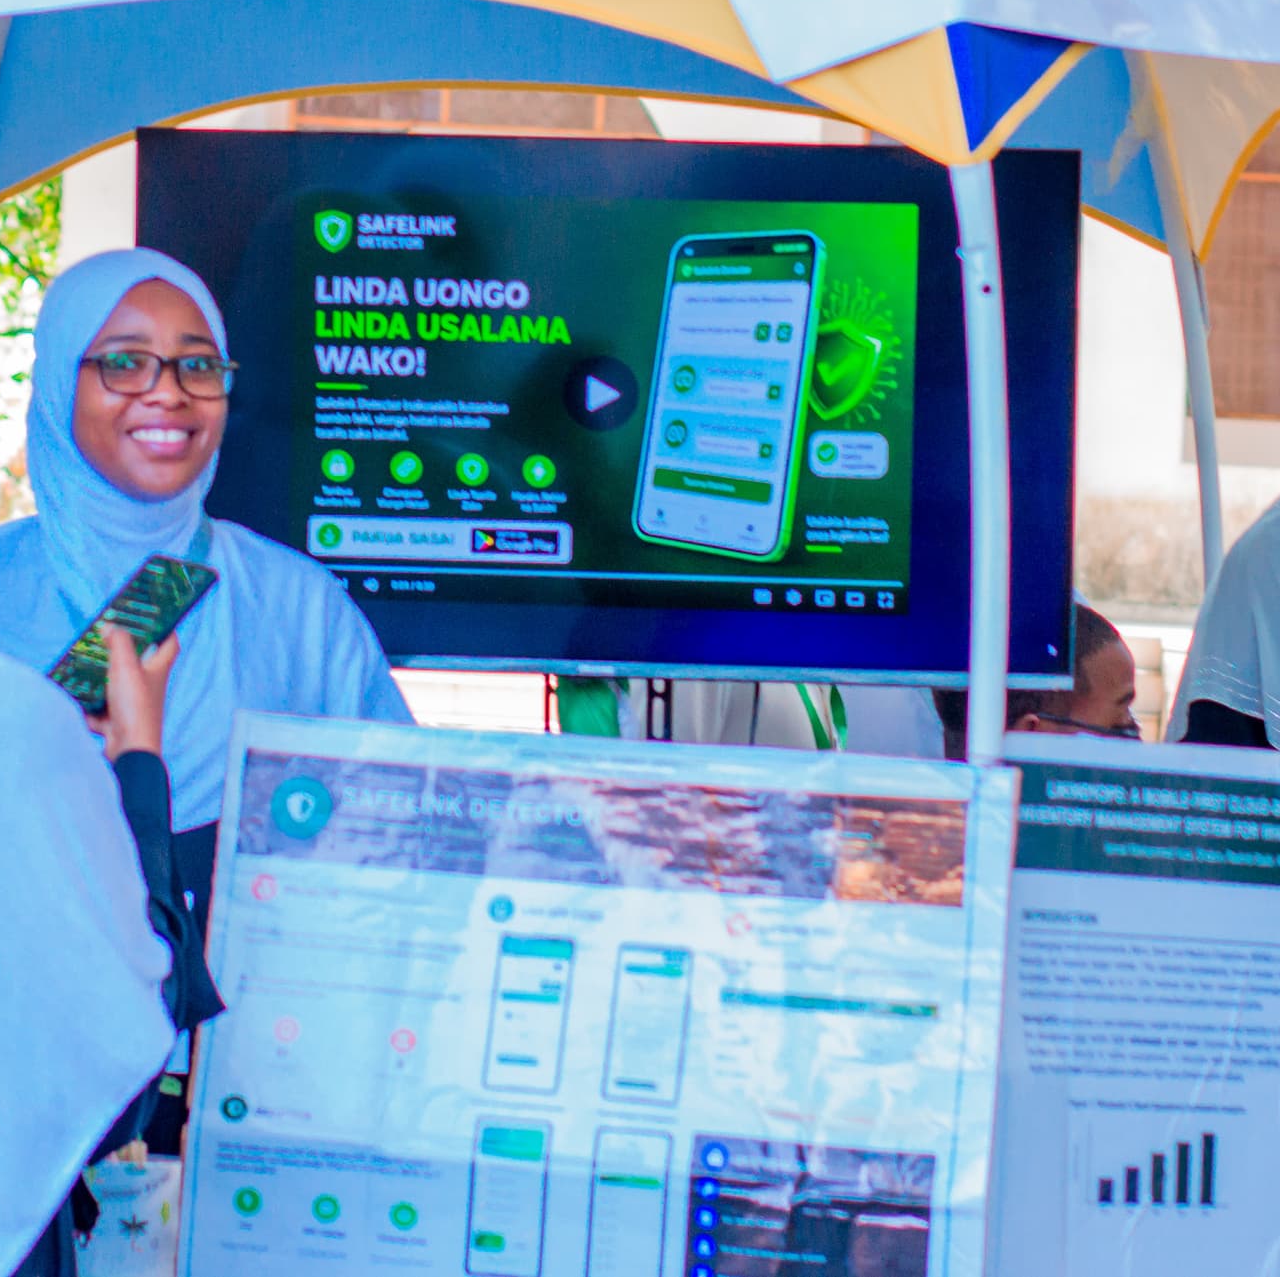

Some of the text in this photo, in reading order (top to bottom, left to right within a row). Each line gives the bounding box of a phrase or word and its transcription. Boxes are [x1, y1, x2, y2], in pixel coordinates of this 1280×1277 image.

[356, 213, 457, 237] SAFELINK
[315, 275, 531, 309] LINDA UONGO
[315, 309, 572, 345] LINDA USALAMA
[314, 344, 428, 376] WAKO!
[341, 784, 464, 818] SAFELINK
